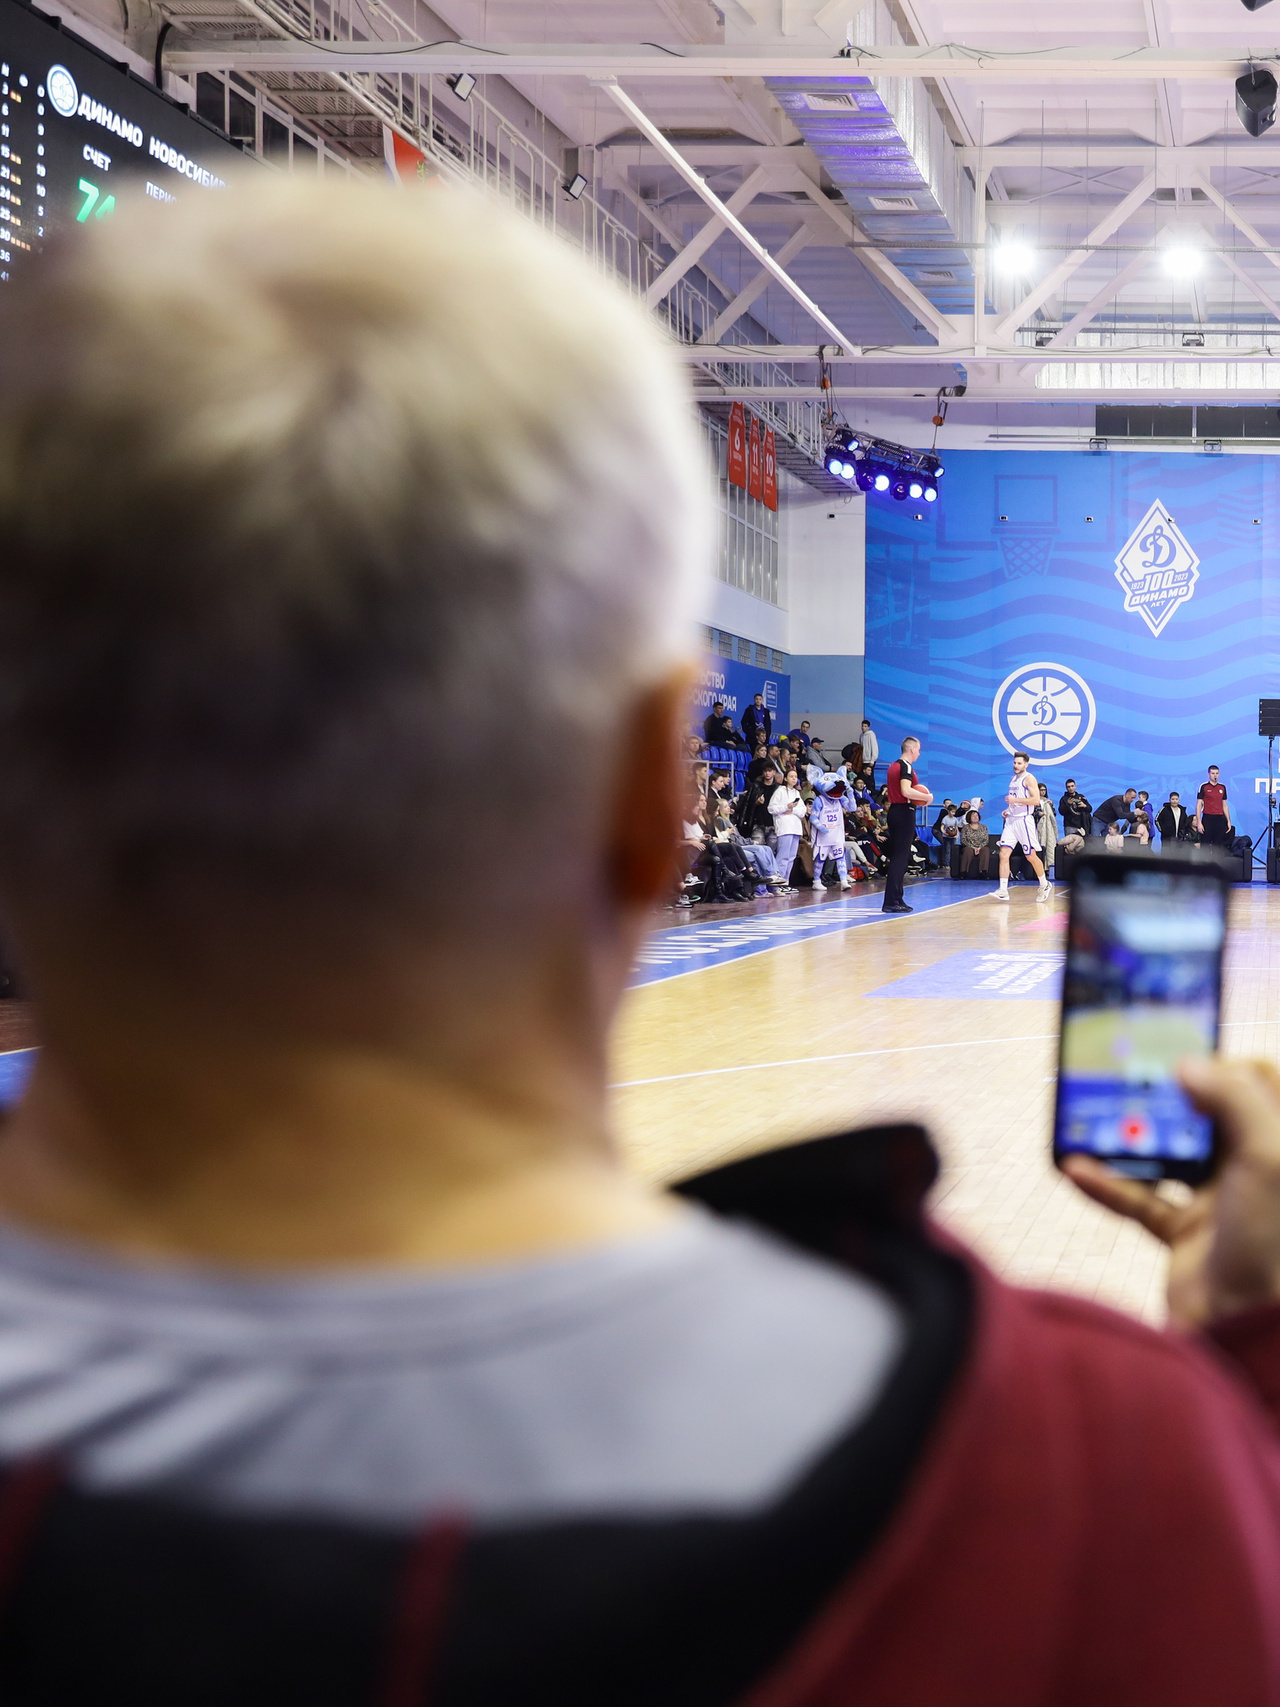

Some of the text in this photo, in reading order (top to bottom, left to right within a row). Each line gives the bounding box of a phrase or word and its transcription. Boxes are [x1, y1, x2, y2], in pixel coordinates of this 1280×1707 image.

[2, 81, 45, 98] 3 0
[1, 102, 45, 116] 6 0
[1, 122, 10, 138] 11
[37, 143, 45, 157] 0
[77, 92, 229, 192] ДИНАМО НОВОСИБИР
[82, 143, 112, 172] СЧЕТ
[0, 164, 10, 180] 21
[0, 182, 46, 201] 24 10
[0, 205, 44, 222] 25 5
[0, 226, 44, 242] 30 2
[735, 428, 741, 451] 6
[1144, 570, 1173, 593] 100
[1130, 586, 1188, 606] ДИНАМО
[1150, 600, 1166, 608] ЛЕТ
[718, 694, 737, 712] КРАЯ
[826, 814, 838, 822] 125
